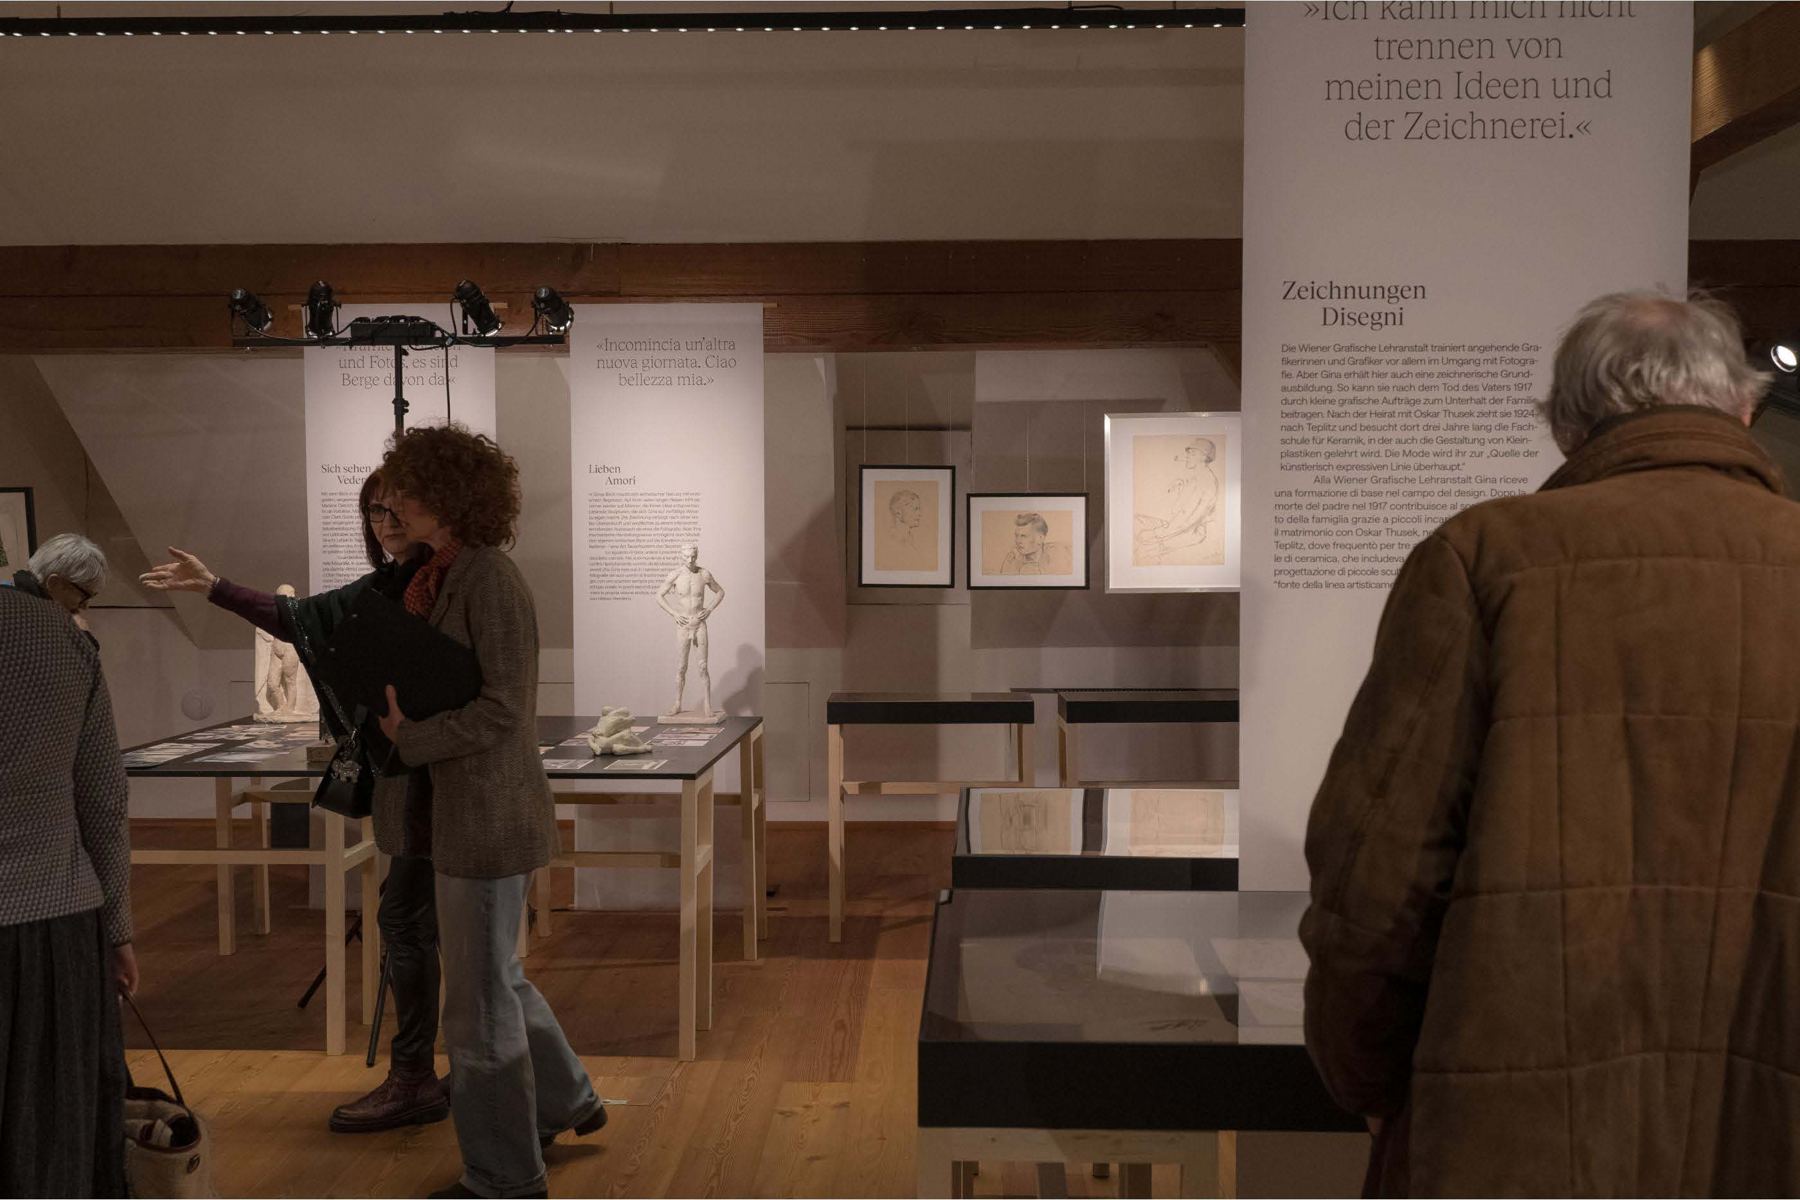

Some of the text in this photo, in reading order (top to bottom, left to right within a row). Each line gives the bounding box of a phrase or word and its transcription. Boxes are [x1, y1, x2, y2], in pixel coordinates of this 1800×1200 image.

[1380, 1, 1456, 20] kann
[1469, 1, 1546, 19] mich
[1557, 1, 1637, 18] nicht
[1374, 36, 1563, 60] trennen von
[1325, 69, 1613, 101] meinen Ideen und
[1345, 111, 1592, 141] der Zeichnerei.«
[1282, 281, 1426, 304] Zeichnungen
[1322, 307, 1404, 331] Disegni
[596, 337, 681, 351] «Incomincia
[1281, 343, 1296, 352] Die
[1298, 343, 1331, 352] Wiener
[1333, 343, 1376, 352] Grafische
[1378, 342, 1428, 352] Lehranstalt
[1430, 342, 1465, 352] trainiert
[1467, 342, 1520, 353] angehende
[339, 356, 365, 369] und
[412, 359, 427, 369] es
[597, 354, 737, 372] nuova giornata. Ciao
[1281, 356, 1325, 365] fikerinnen
[1327, 356, 1345, 365] und
[1347, 356, 1383, 365] Grafiker
[1401, 356, 1426, 365] allem
[1441, 355, 1481, 367] Umgang
[1482, 355, 1498, 365] mit
[618, 373, 714, 386] bellezza mia.»
[1296, 369, 1318, 379] Aber
[1320, 369, 1342, 379] Gina
[1343, 369, 1369, 378] erhält
[1371, 369, 1388, 378] hier
[1390, 369, 1413, 378] auch
[1414, 369, 1435, 378] eine
[1436, 369, 1498, 378] zeichnerische
[342, 373, 380, 389] Berge
[1336, 382, 1349, 392] So
[1351, 382, 1375, 392] kann
[1377, 382, 1390, 391] sie
[1392, 382, 1415, 391] nach
[1417, 382, 1439, 391] dem
[1442, 382, 1459, 391] Tod
[1461, 382, 1479, 391] des
[1481, 382, 1511, 391] Vaters
[1513, 381, 1532, 391] 1917
[1280, 396, 1308, 405] durch
[1309, 395, 1336, 405] kleine
[1337, 395, 1379, 407] grafische
[1381, 395, 1421, 406] Aufträge
[1445, 395, 1487, 404] Unterhalt
[1488, 395, 1504, 404] der
[1326, 408, 1351, 418] Nach
[1352, 408, 1367, 418] der
[1369, 408, 1396, 418] Heirat
[1397, 408, 1412, 418] mit
[1413, 408, 1440, 417] Oskar
[1442, 408, 1475, 417] Thusek
[1476, 408, 1498, 417] zieht
[1499, 408, 1512, 417] sie
[1280, 422, 1304, 431] nach
[1306, 422, 1337, 433] Teplitz
[1338, 422, 1357, 431] und
[1359, 422, 1397, 431] besucht
[1399, 421, 1420, 431] dort
[1422, 421, 1440, 431] drei
[1442, 421, 1470, 431] Jahre
[1471, 421, 1492, 432] lang
[1494, 421, 1509, 430] die
[1280, 435, 1310, 445] schule
[1377, 435, 1393, 444] der
[1395, 435, 1418, 444] auch
[1419, 435, 1434, 444] die
[1435, 435, 1485, 446] Gestaltung
[1487, 436, 1504, 444] von
[1280, 448, 1322, 460] plastiken
[1323, 448, 1358, 459] gelehrt
[1384, 448, 1400, 457] Die
[1402, 448, 1430, 457] Mode
[1432, 448, 1452, 457] wird
[1522, 447, 1538, 457] der
[321, 464, 371, 473] Sich sehen
[589, 464, 621, 473] Lieben
[1280, 461, 1334, 471] künstlerisch
[1335, 461, 1388, 472] expressiven
[1390, 461, 1411, 470] Linie
[605, 476, 636, 485] Amori
[1313, 474, 1528, 484] Alla Wiener Grafische Lehranstalt Gina riceve
[1294, 488, 1348, 497] formazione
[1360, 487, 1383, 497] base
[1385, 487, 1400, 497] nel
[1401, 489, 1435, 499] campo
[1437, 487, 1452, 497] del
[1274, 500, 1447, 512] morte del padre nel 1917 contribuisce
[1286, 513, 1422, 525] della famiglia grazie piccoli
[1280, 527, 1334, 537] matrimonio
[1355, 527, 1382, 536] Oskar
[1307, 540, 1330, 550] dove
[1341, 553, 1359, 563] che
[1361, 553, 1404, 563] includeva
[1274, 566, 1379, 578] progettazione piccole
[1302, 580, 1323, 589] della
[1324, 580, 1345, 589] linea
